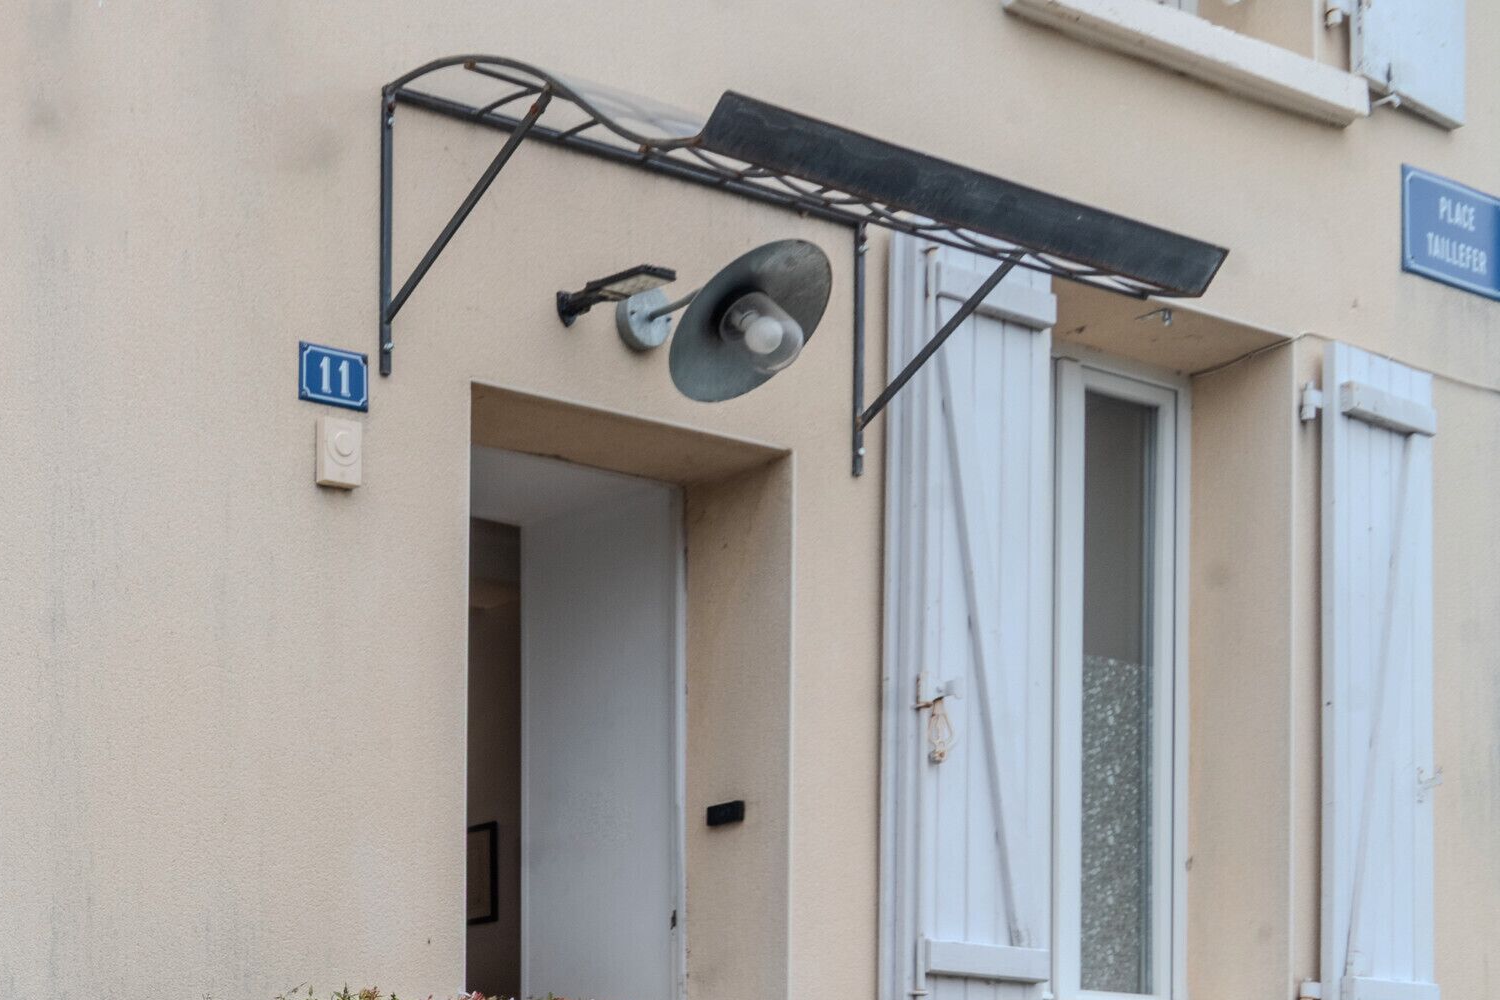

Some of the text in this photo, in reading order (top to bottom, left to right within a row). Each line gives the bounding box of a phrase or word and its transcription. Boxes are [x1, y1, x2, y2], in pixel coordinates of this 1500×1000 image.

[1439, 197, 1475, 231] PLACE
[1426, 231, 1487, 275] TAILLEFER
[320, 356, 350, 397] 11
